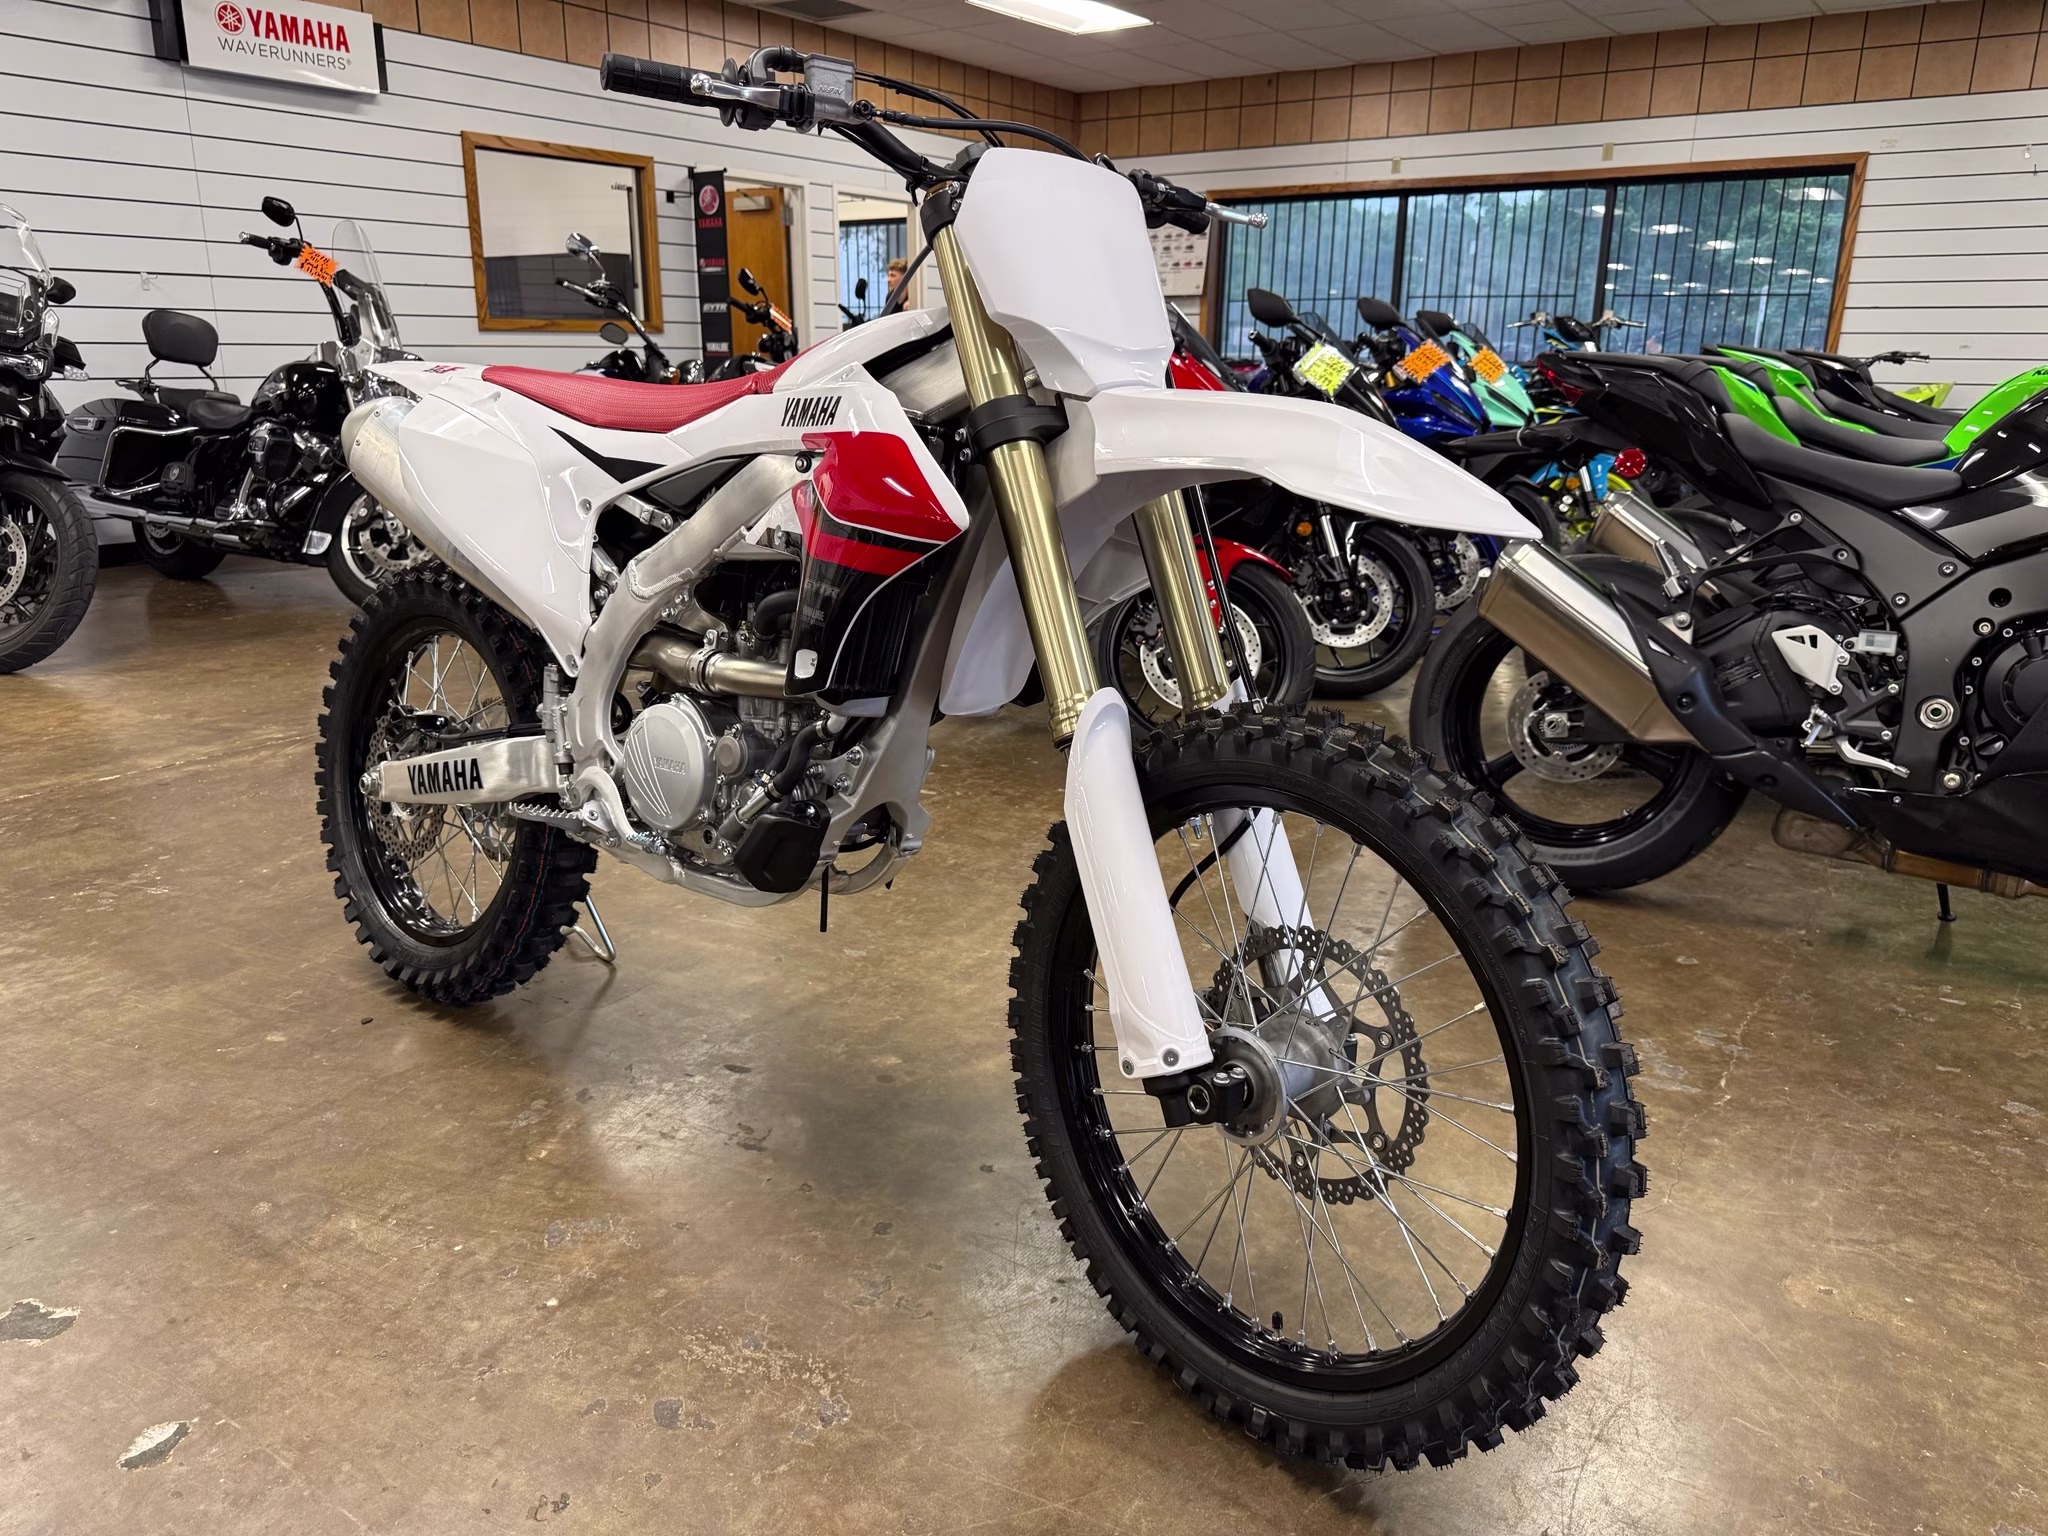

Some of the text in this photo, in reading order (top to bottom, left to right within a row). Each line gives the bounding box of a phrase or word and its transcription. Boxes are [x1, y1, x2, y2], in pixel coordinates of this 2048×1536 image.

[246, 7, 351, 54] YAMAHA
[781, 395, 842, 428] YAMAHA
[407, 757, 484, 796] YAMAHA
[653, 755, 686, 776] YAMAHA
